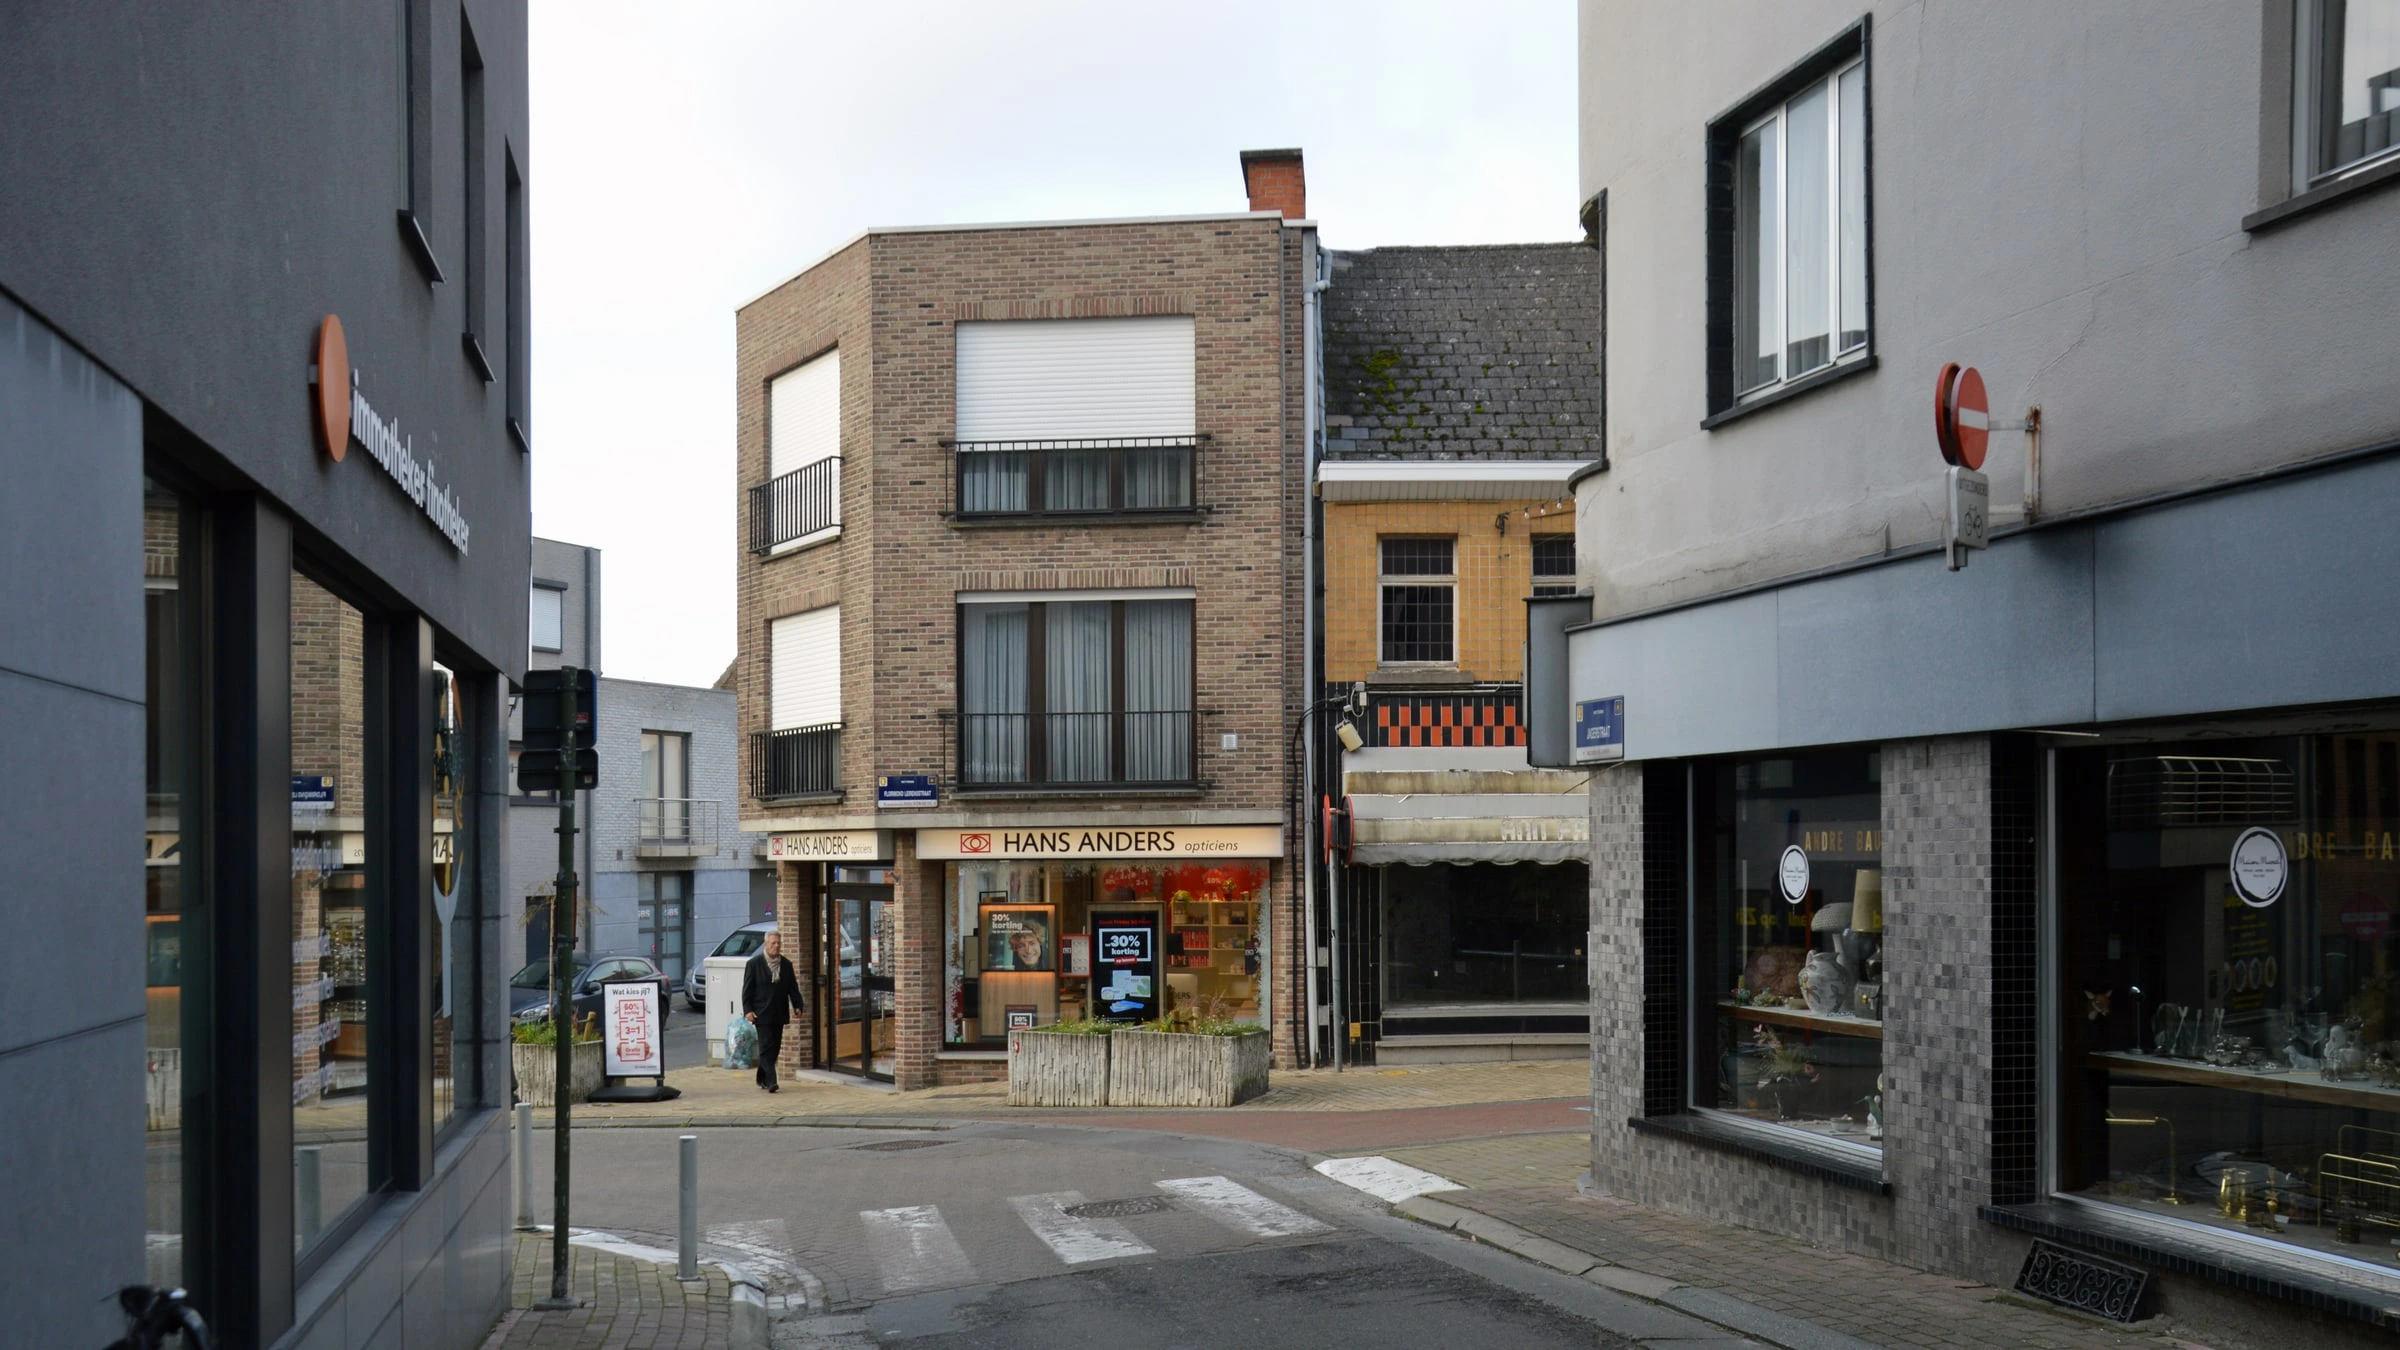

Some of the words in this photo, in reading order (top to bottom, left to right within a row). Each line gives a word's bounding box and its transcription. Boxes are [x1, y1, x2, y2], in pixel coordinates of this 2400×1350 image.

[352, 368, 426, 508] immotheker
[425, 459, 470, 556] finotheker
[786, 837, 810, 855] HANS
[813, 836, 848, 855] ANDERS
[851, 843, 873, 854] opticiens
[1004, 832, 1070, 852] HANS
[1078, 831, 1175, 852] ANDERS
[1184, 839, 1239, 853] opticiens
[1804, 831, 1845, 851] ANDRE
[2364, 832, 2400, 860] BA
[992, 921, 1023, 929] korting
[1111, 948, 1140, 956] korting
[612, 988, 625, 996] Wat
[640, 987, 651, 997] jij?
[625, 1026, 641, 1035] 3=1
